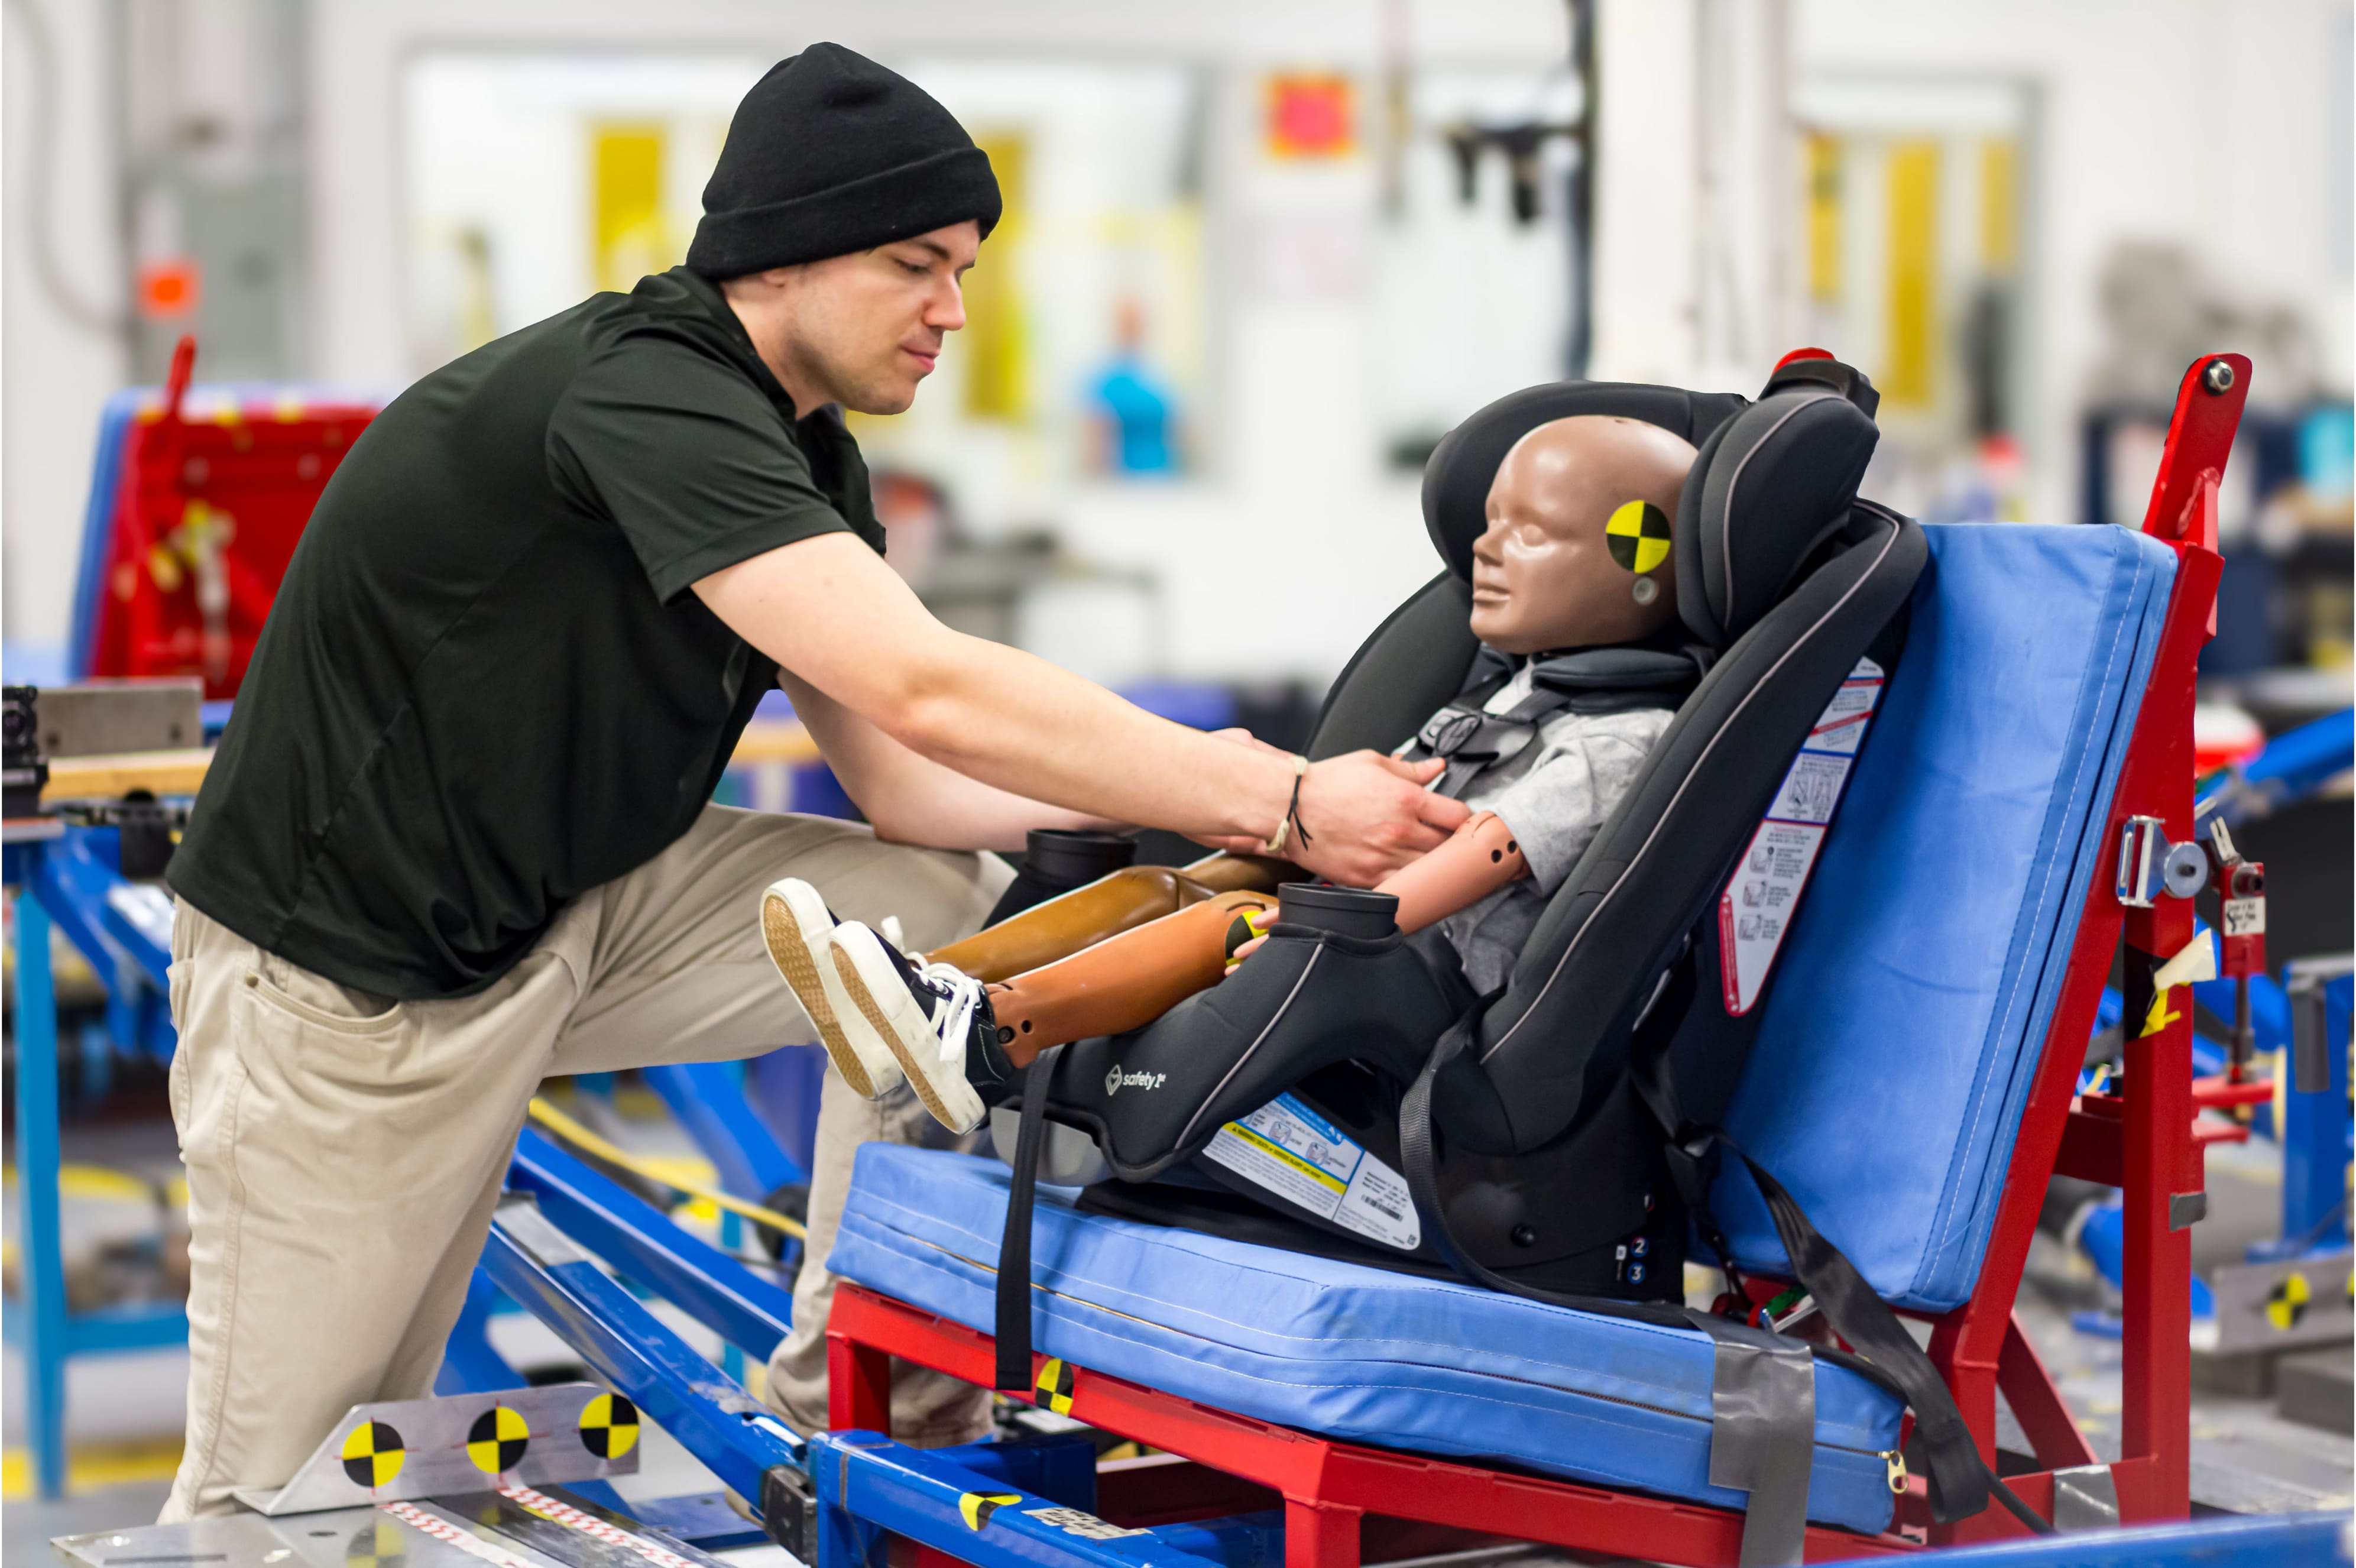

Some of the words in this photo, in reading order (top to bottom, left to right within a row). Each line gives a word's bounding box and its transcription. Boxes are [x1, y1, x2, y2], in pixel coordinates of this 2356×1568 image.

[1123, 1071, 1155, 1090] safety
[1635, 1239, 1646, 1253] 2
[1632, 1266, 1642, 1281] 3
